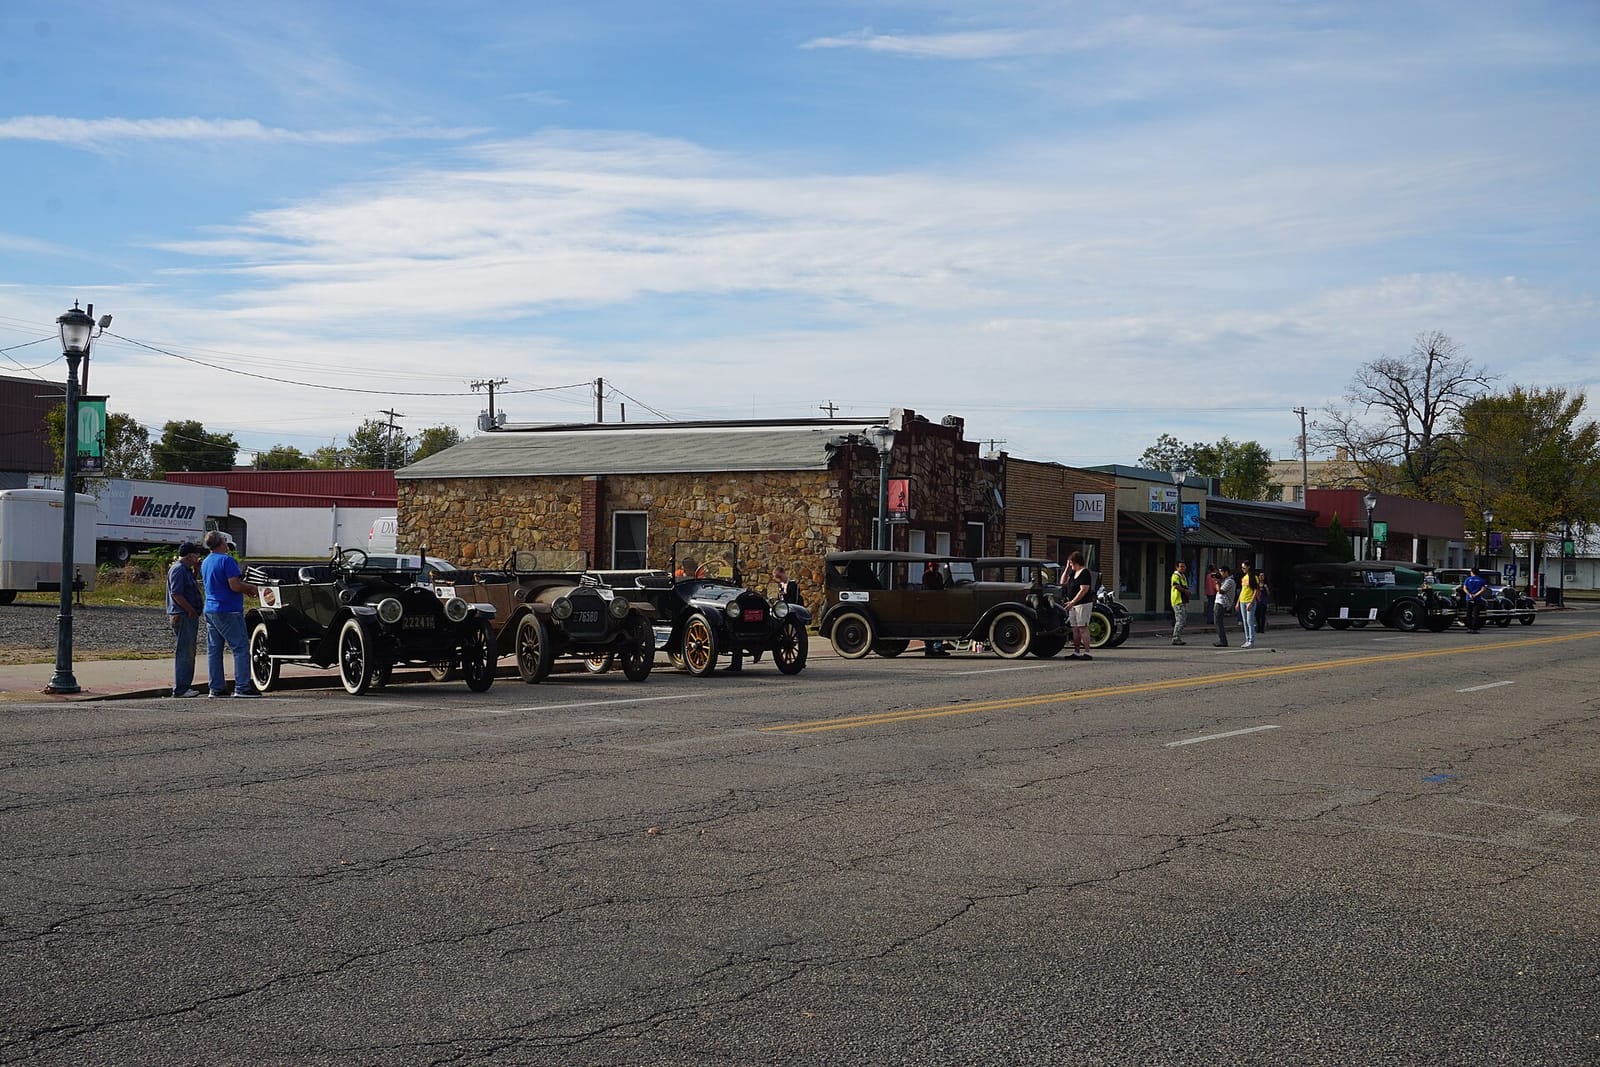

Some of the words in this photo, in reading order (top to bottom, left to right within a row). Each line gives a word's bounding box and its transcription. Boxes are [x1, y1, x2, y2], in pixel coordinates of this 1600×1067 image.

[130, 495, 196, 519] Wheaton
[1076, 499, 1103, 512] DME
[1161, 502, 1176, 513] PLACE
